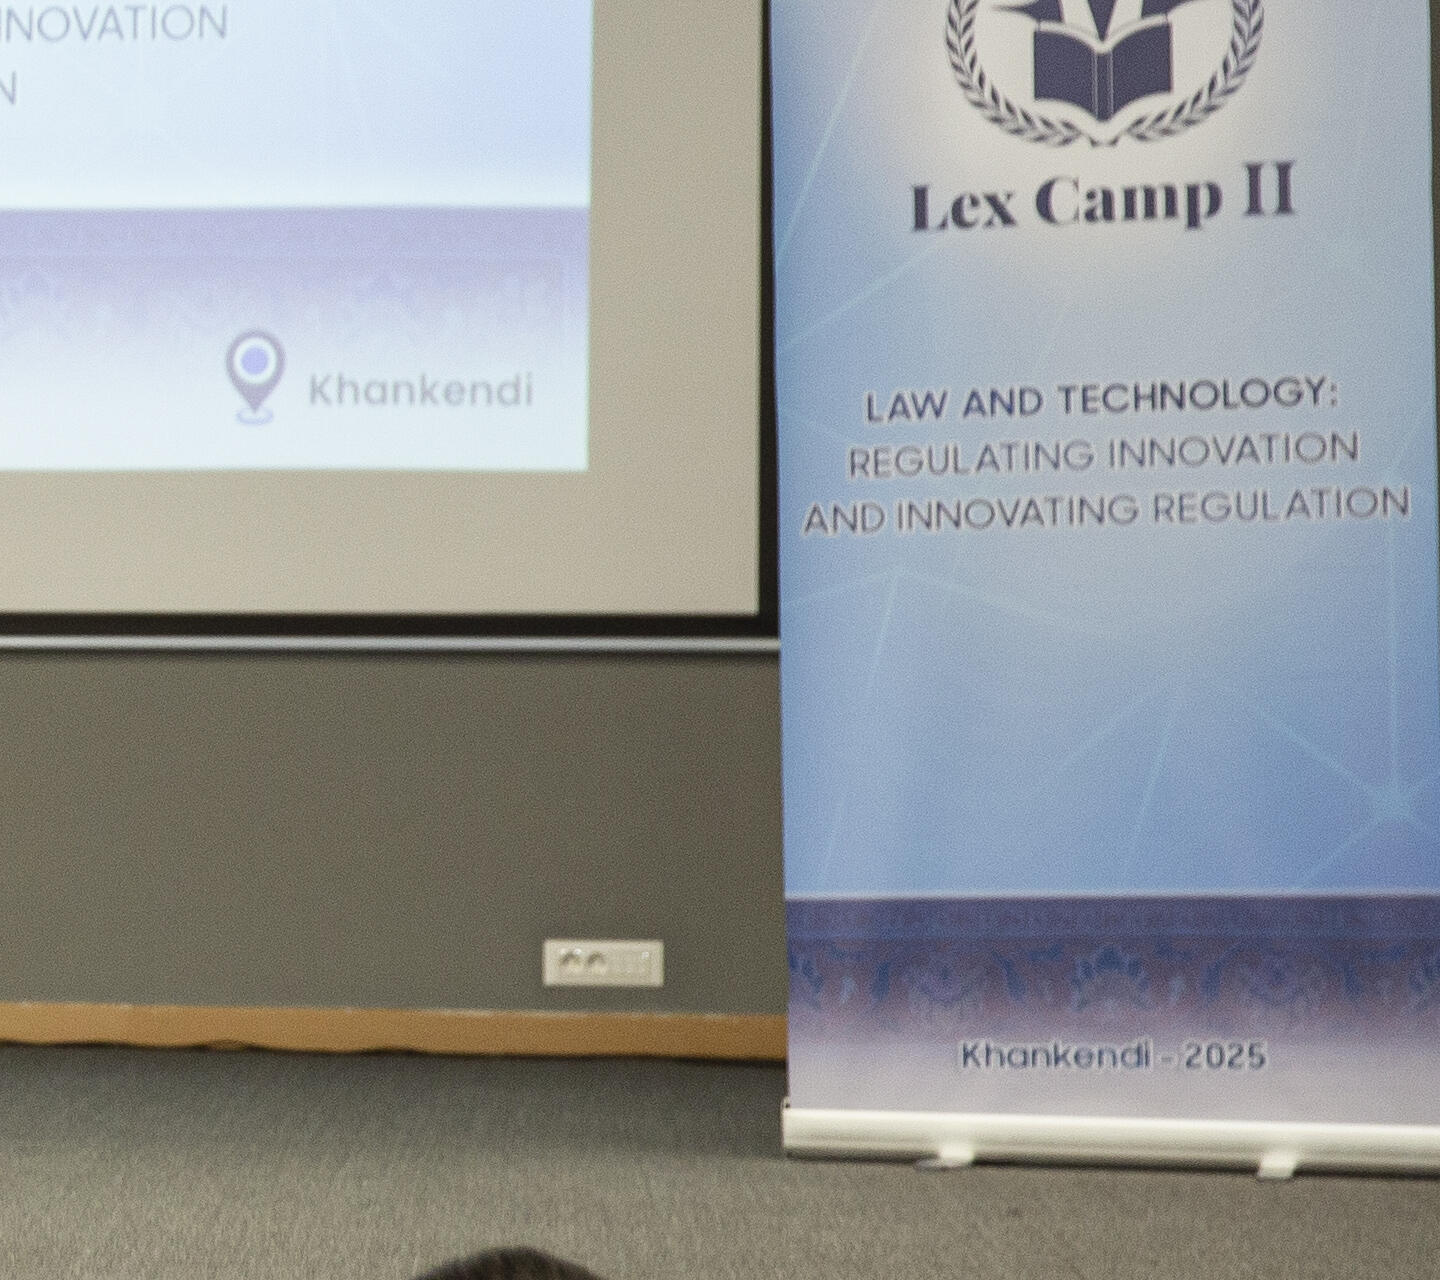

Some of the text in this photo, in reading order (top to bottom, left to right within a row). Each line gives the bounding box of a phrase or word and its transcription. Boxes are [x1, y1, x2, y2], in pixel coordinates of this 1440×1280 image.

[913, 161, 1293, 231] Lex Camp II
[309, 373, 533, 407] Khankendi
[867, 377, 1338, 422] LAW AND TECHNOLOGY:
[850, 433, 1357, 477] REGULATING INNOVATION
[803, 487, 1409, 534] AND INNOVATING REGULATION
[962, 1040, 1150, 1070] Khankendi
[1185, 1045, 1265, 1070] 2025
